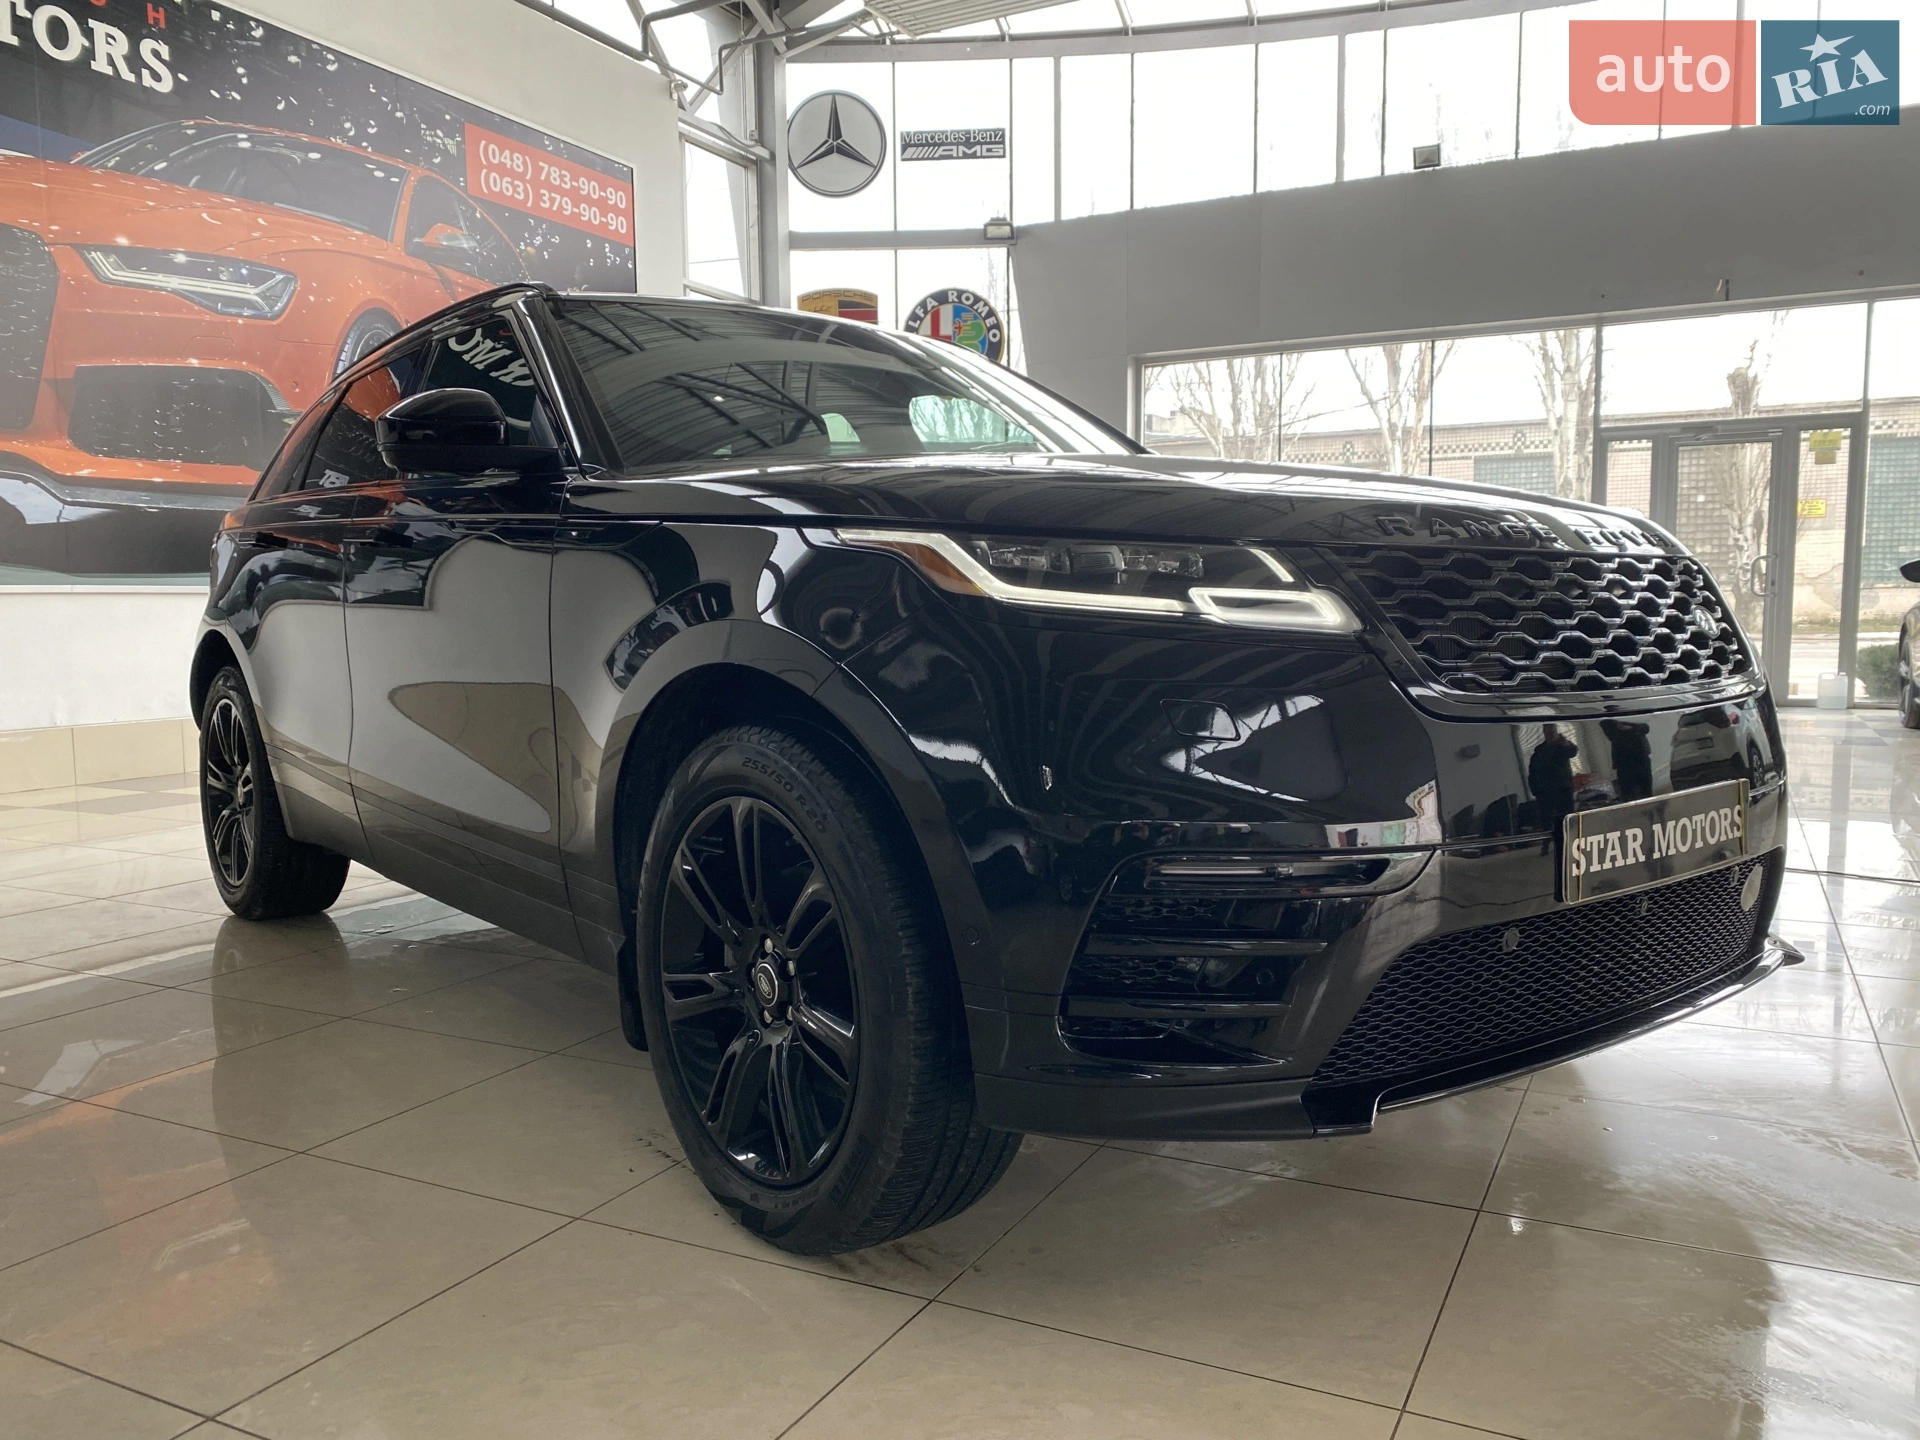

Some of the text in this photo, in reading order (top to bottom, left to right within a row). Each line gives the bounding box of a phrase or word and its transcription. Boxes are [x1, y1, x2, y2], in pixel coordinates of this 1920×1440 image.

[901, 129, 1003, 144] Mercedes-Benz
[479, 140, 627, 209] (048) 783-90-90
[480, 169, 627, 234] (063) 379-90-90
[801, 289, 874, 303] PORSCHE
[908, 290, 1001, 343] LFA ROMEO
[1375, 516, 1559, 543] RANGE
[742, 757, 793, 792] 255/50
[1572, 804, 1743, 877] STAR MOTORS
